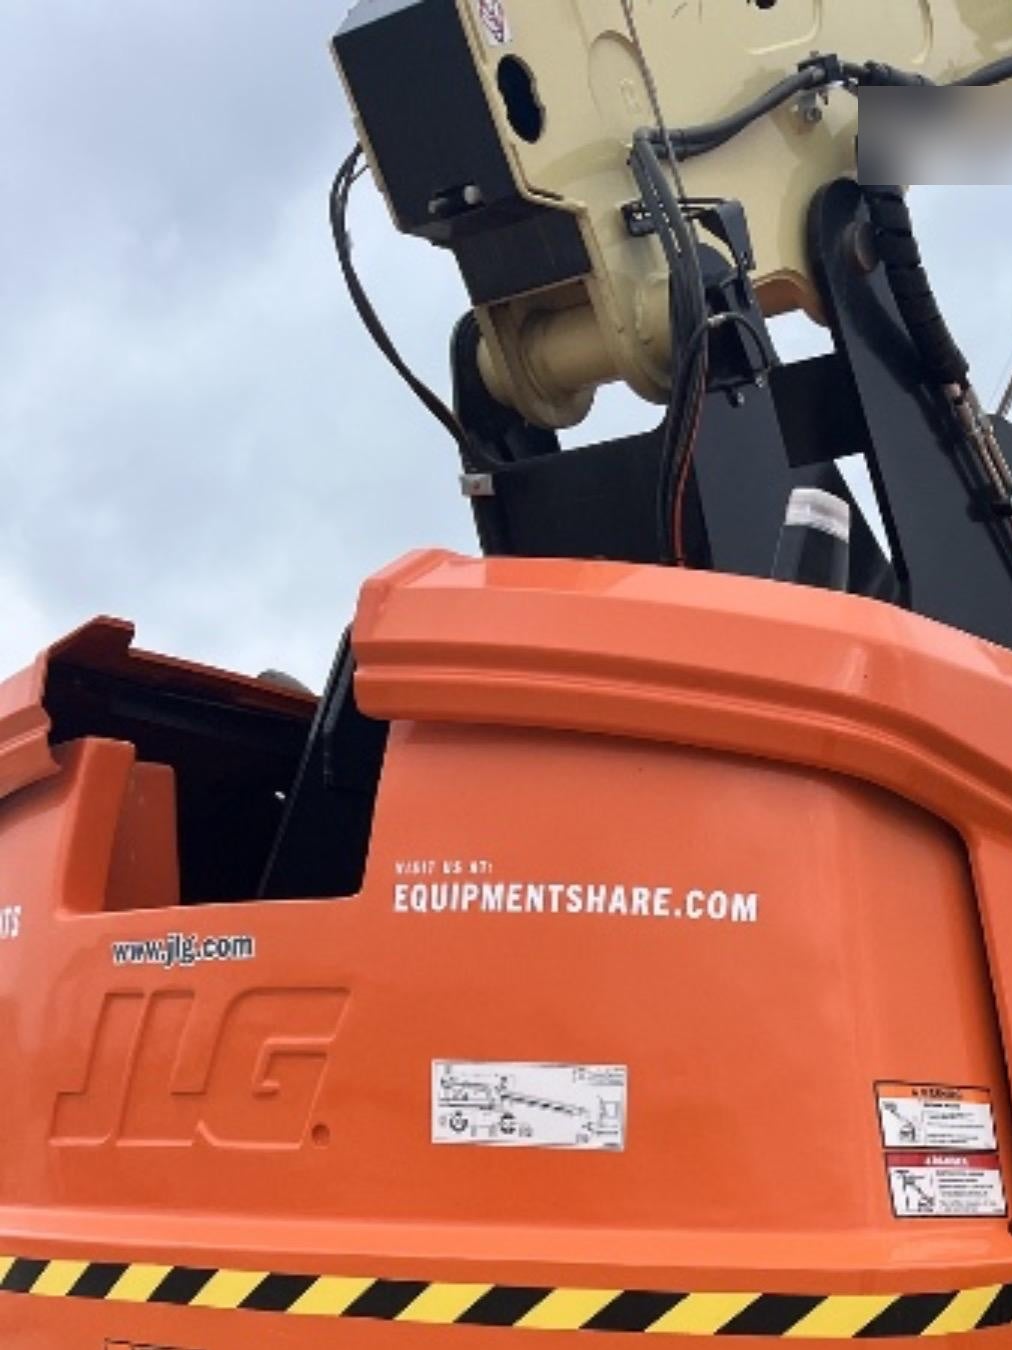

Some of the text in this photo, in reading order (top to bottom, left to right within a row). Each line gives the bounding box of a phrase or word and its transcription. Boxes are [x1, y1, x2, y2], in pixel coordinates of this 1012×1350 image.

[395, 860, 435, 875] VISIT
[443, 860, 462, 875] US
[394, 883, 758, 922] EQUIPMENTSHARE.COM
[112, 933, 255, 968] www.jlg.com
[49, 986, 351, 1148] JLG
